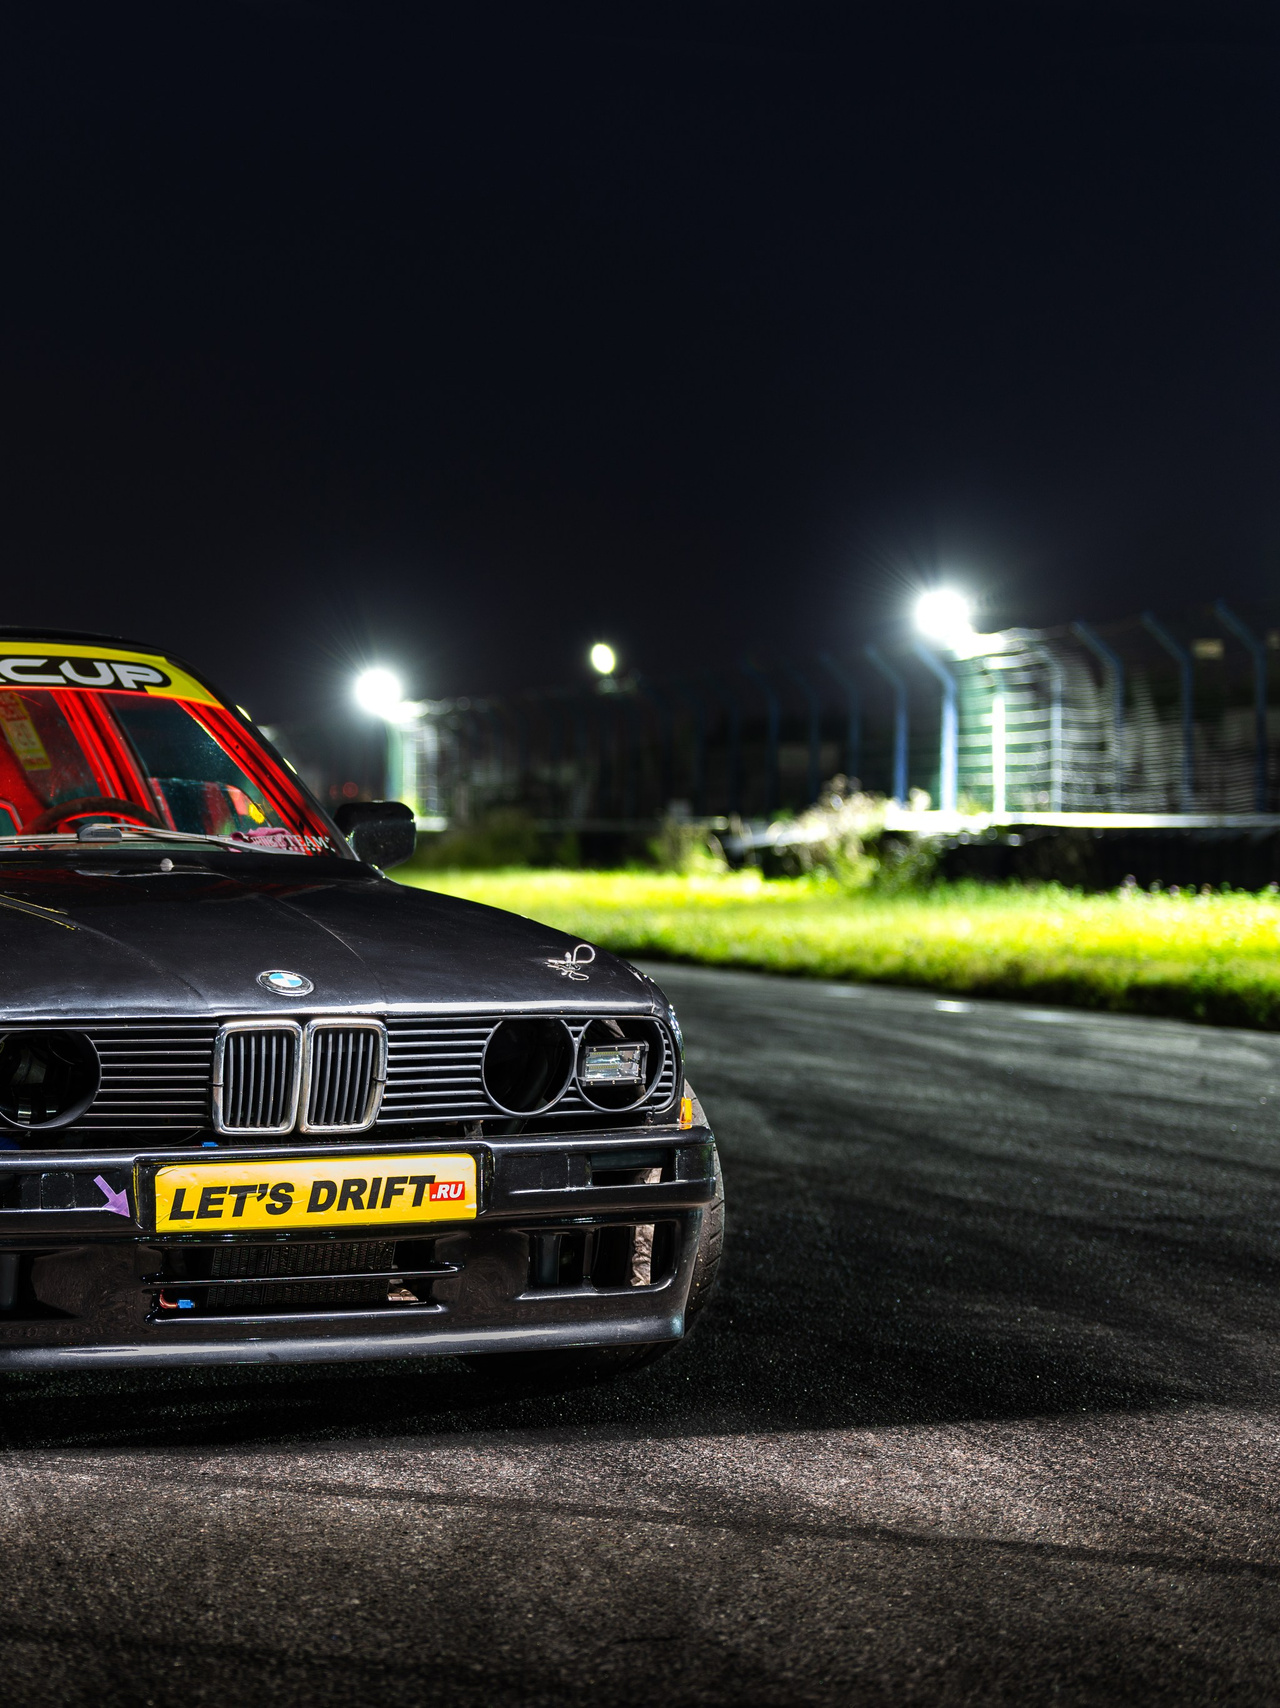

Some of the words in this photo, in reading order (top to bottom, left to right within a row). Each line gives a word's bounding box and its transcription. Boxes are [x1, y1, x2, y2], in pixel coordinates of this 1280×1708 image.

[168, 1182, 296, 1221] LET'S
[306, 1175, 436, 1213] DRIFT
[431, 1183, 464, 1200] .RU
